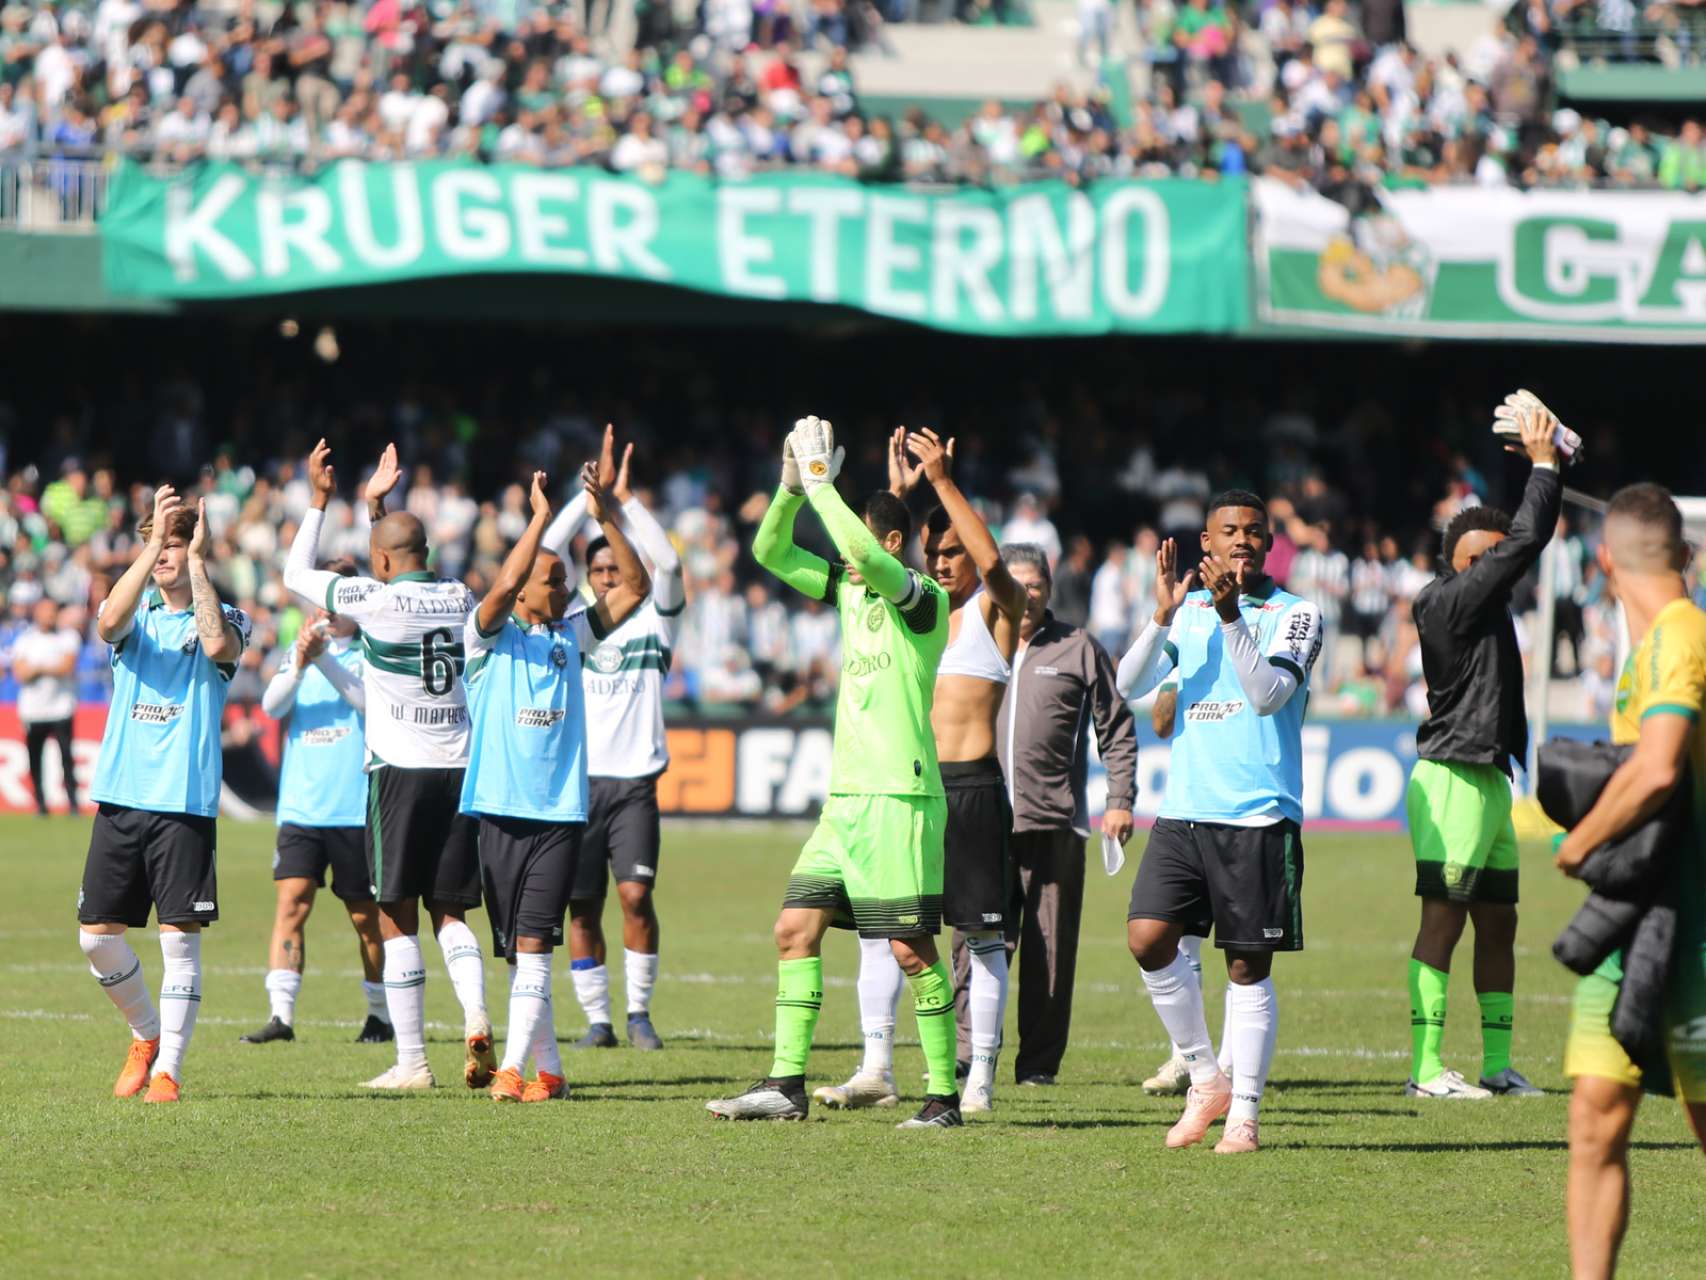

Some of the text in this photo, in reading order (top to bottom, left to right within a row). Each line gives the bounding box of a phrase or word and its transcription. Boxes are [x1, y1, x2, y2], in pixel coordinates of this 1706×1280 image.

[164, 160, 1171, 322] KRUGER ETERNO
[422, 626, 457, 698] 6
